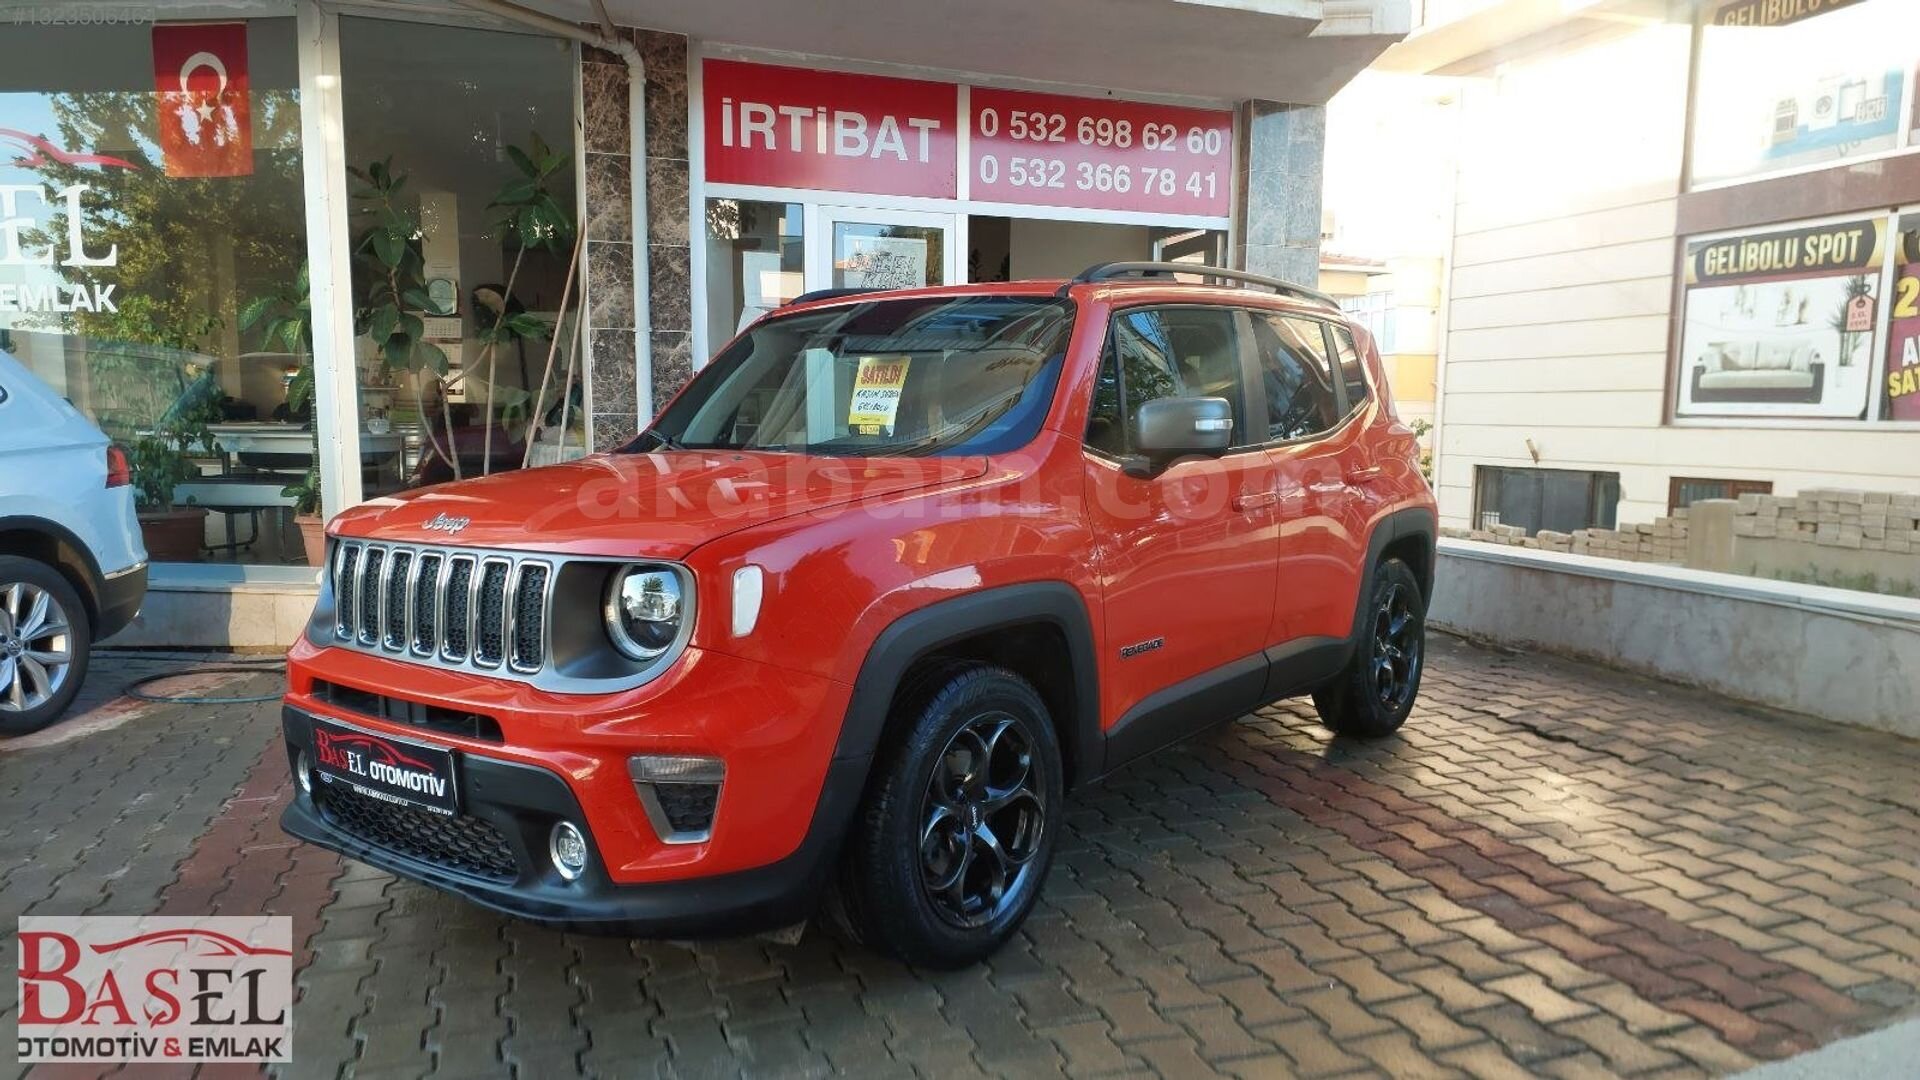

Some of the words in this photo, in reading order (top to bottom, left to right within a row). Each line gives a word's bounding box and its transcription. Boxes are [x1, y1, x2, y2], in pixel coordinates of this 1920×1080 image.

[722, 97, 941, 163] İRTİBAT
[980, 108, 998, 137] 0
[1009, 110, 1067, 142] 532
[1077, 116, 1132, 148] 698
[1142, 122, 1177, 151] 62
[1187, 126, 1222, 156] 60
[980, 155, 998, 184] 0
[1009, 157, 1066, 188] 532
[1076, 162, 1131, 193] 366
[1141, 167, 1176, 196] 78
[1186, 172, 1216, 199] 41
[1704, 239, 1799, 276] GELİBOLU
[1803, 230, 1863, 267] SPOT
[0, 284, 118, 312] EMLAK
[422, 512, 471, 535] Jeep
[316, 728, 367, 776] BASEL
[369, 760, 446, 798] OTOMOTİV
